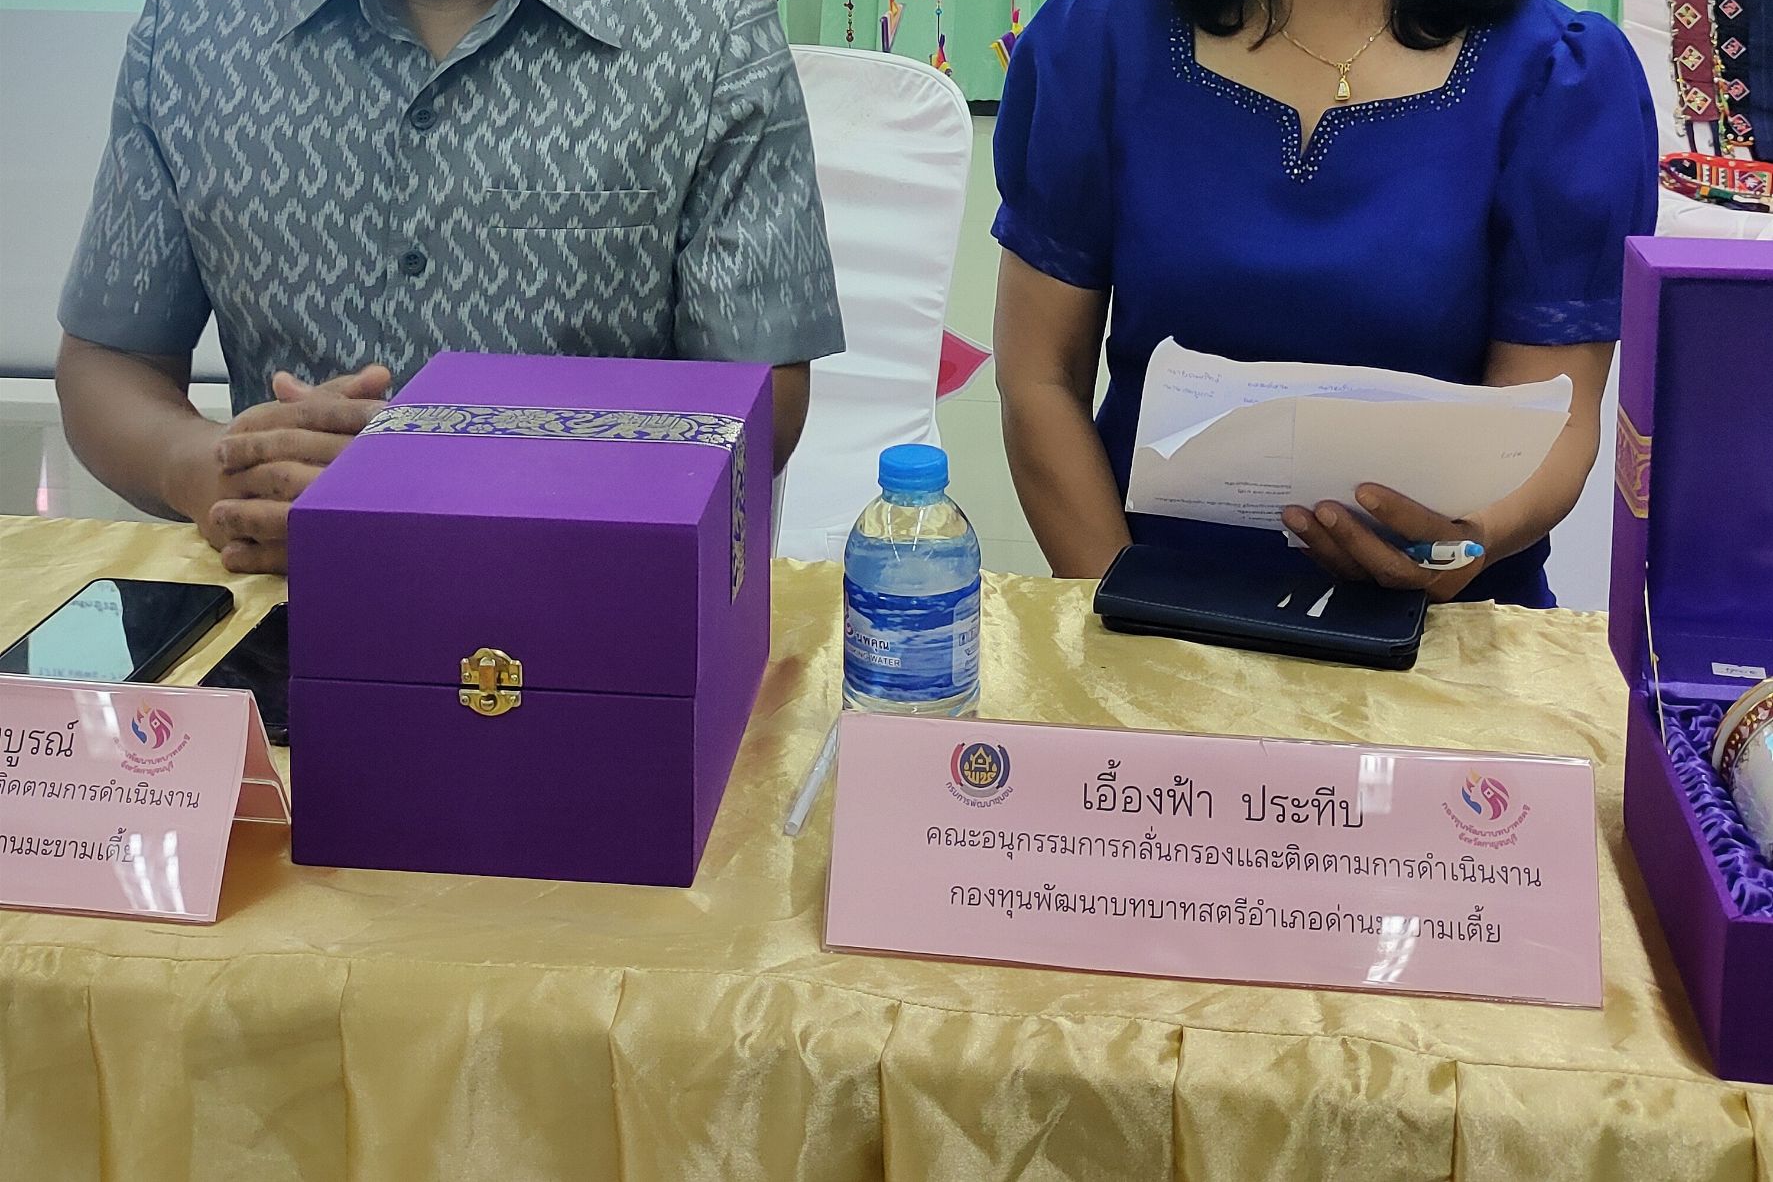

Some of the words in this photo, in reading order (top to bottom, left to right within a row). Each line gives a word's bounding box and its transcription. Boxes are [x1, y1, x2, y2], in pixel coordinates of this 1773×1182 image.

[870, 654, 901, 667] WATER
[0, 719, 80, 768] บูรณ์
[1083, 758, 1215, 819] เอื้องฟ้า
[926, 824, 1543, 889] คณะอนุกรรมการกลั่นกรองและติดตามการดำเนินงาน
[949, 883, 1502, 945] กองทุนพัฒนาบทบาทสตรีอำเภอด่านามเตี้ย
